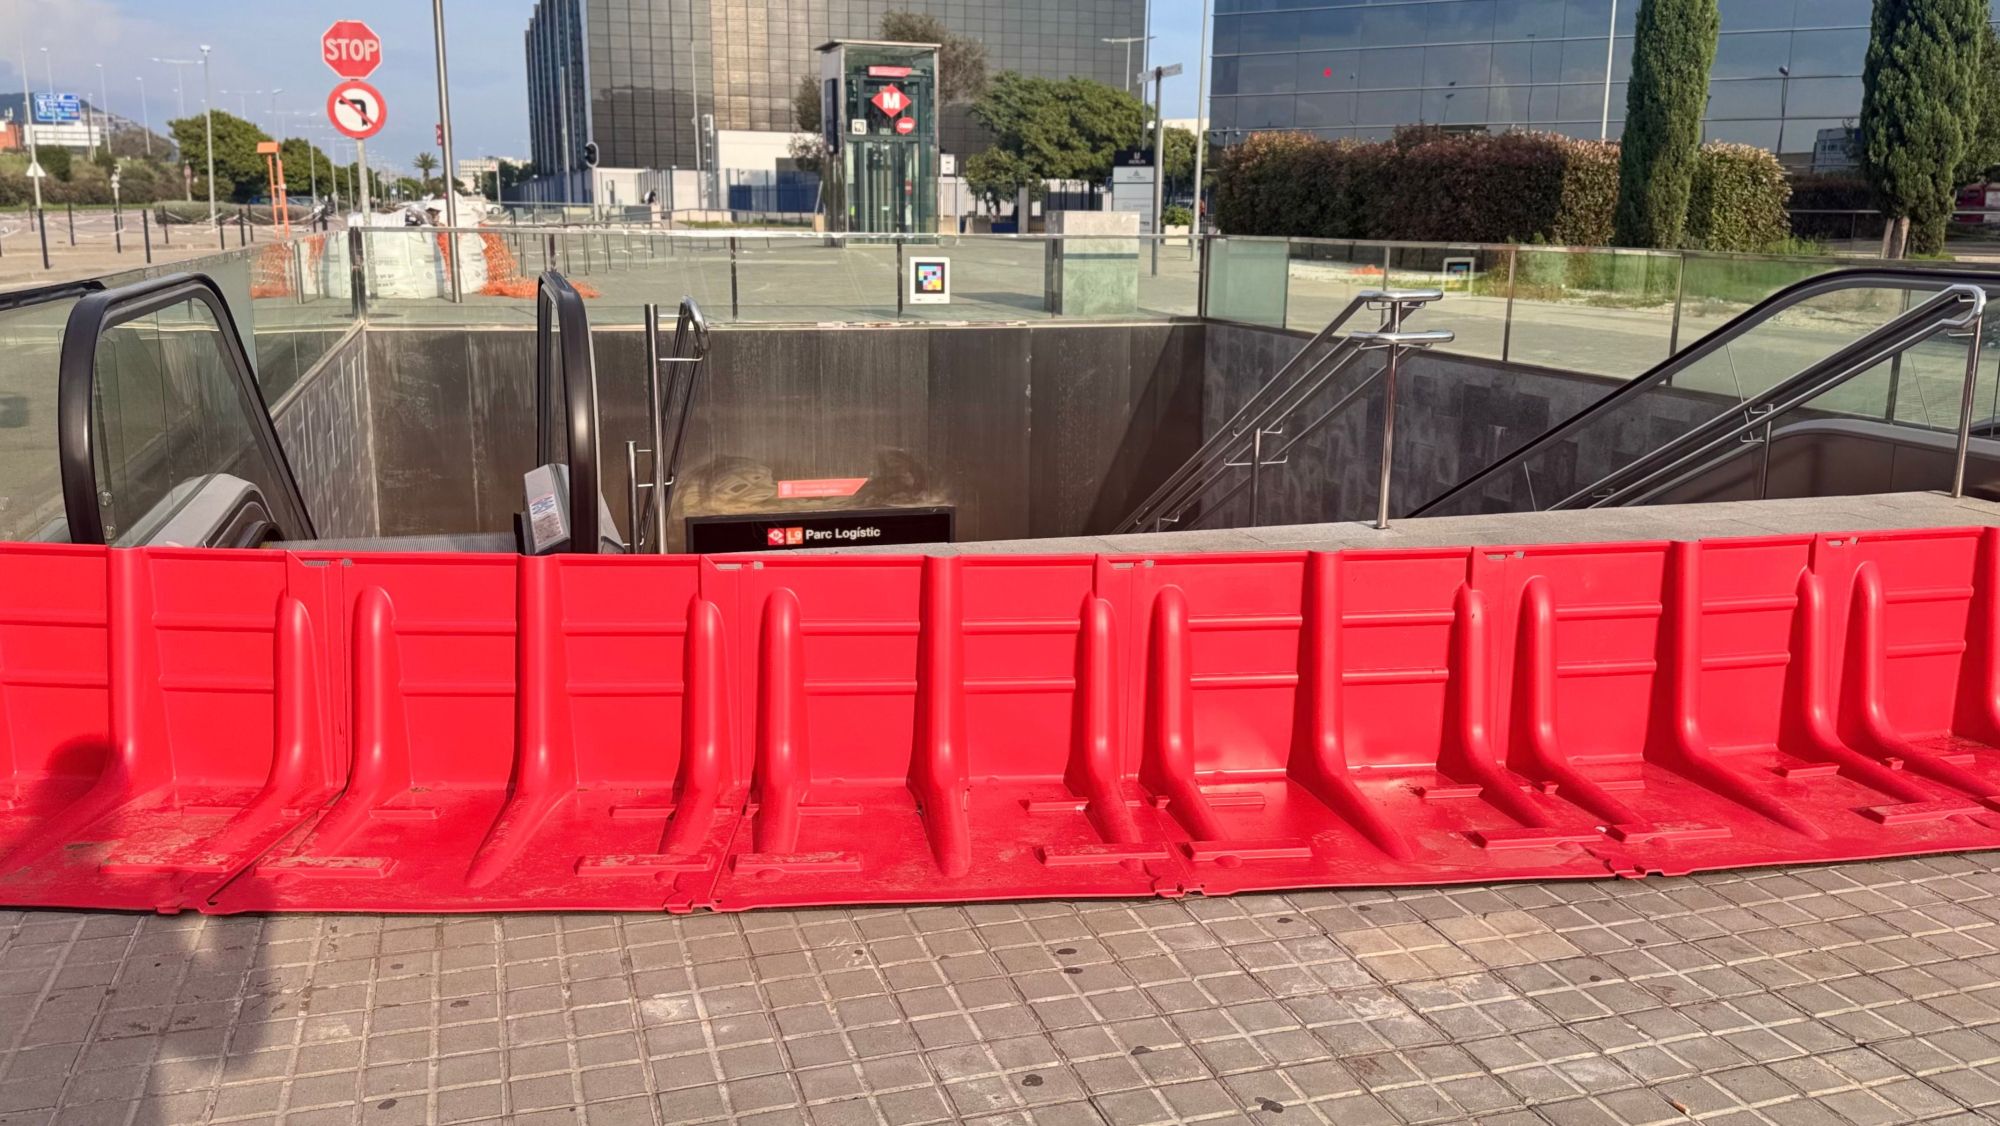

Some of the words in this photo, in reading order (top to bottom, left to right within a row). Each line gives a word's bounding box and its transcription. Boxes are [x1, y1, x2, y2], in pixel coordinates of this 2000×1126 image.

[325, 38, 378, 62] STOP
[883, 92, 900, 109] M
[787, 531, 801, 540] L9
[805, 529, 832, 540] Parc
[835, 526, 881, 540] Logístic
